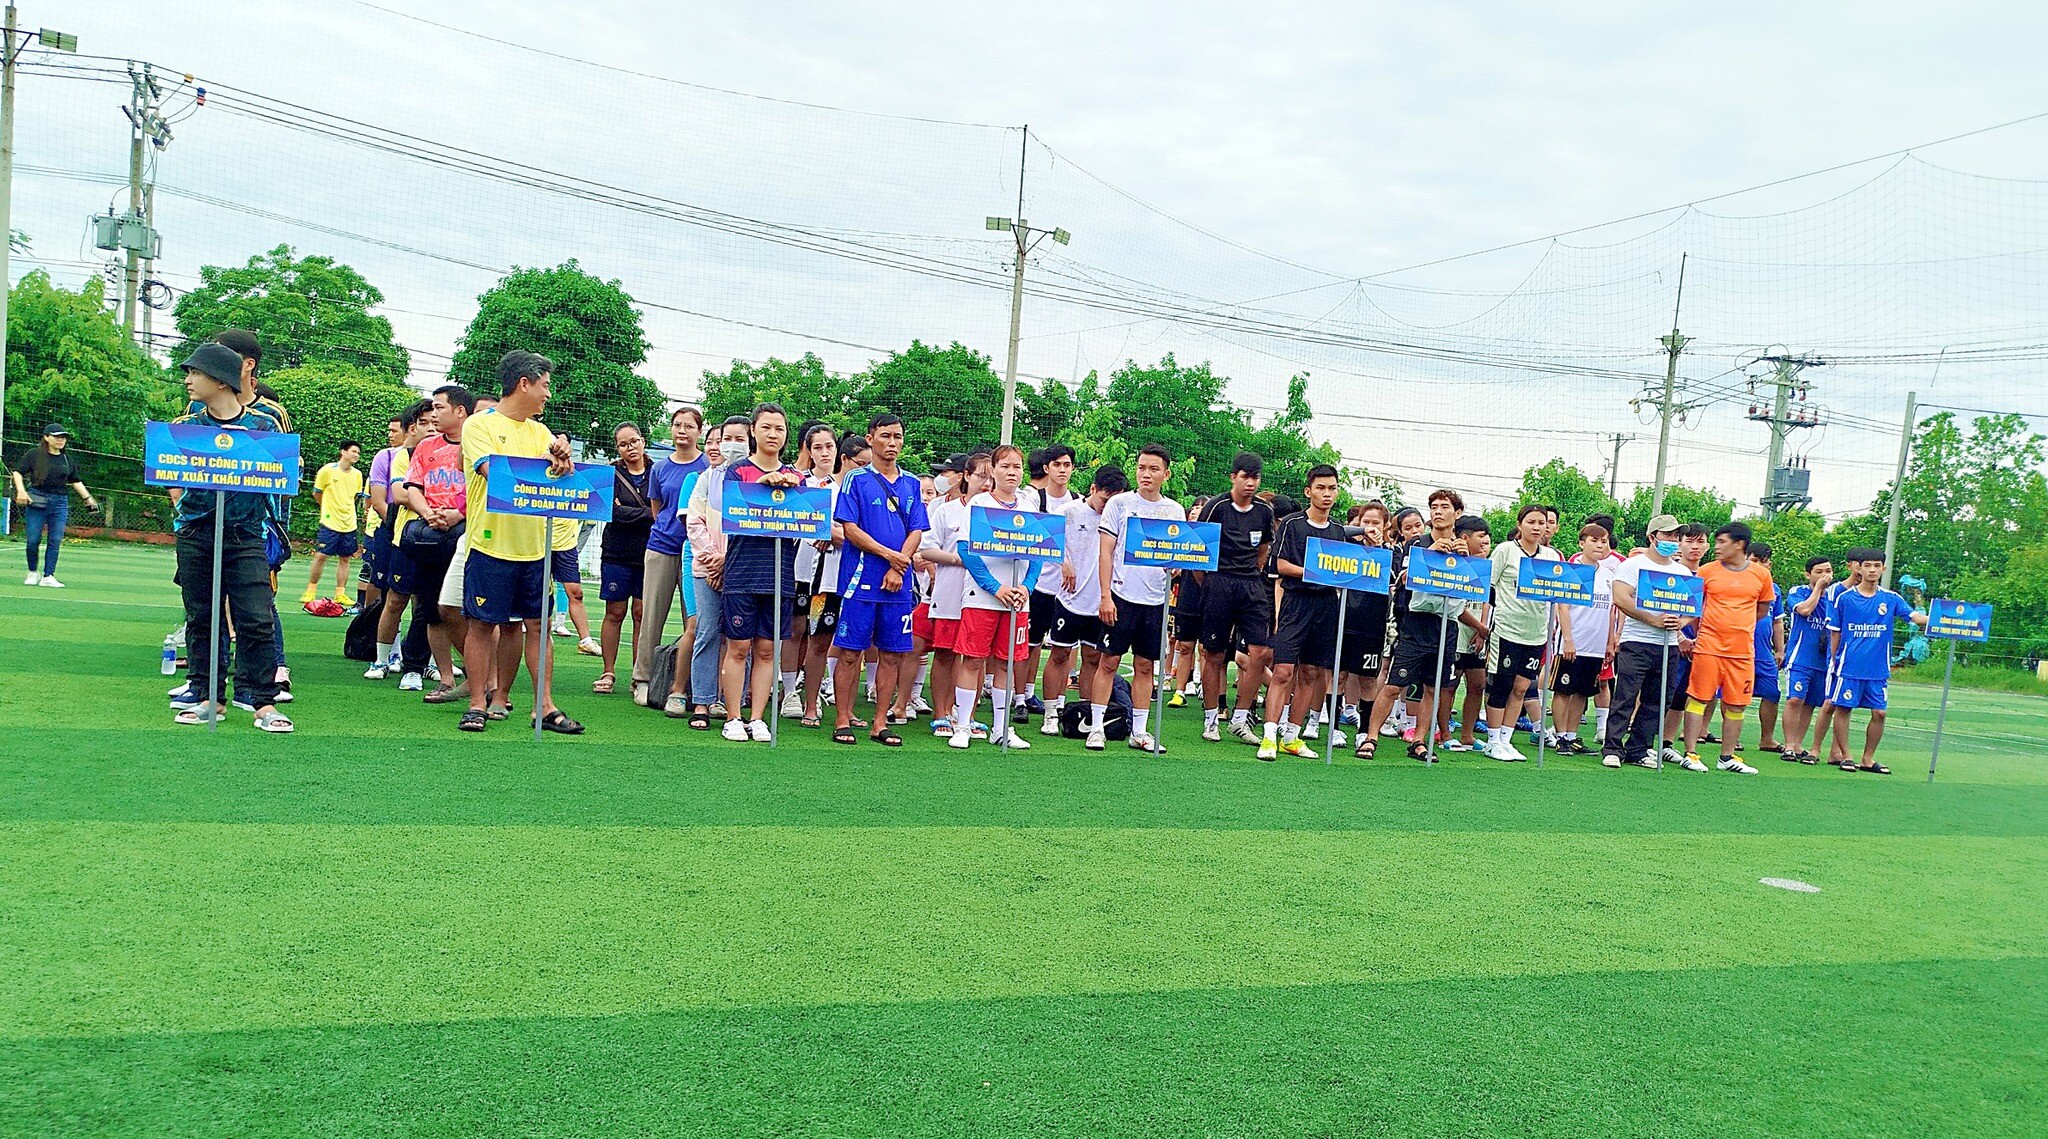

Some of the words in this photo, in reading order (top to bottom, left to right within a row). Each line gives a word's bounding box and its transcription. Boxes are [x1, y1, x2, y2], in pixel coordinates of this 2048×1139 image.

[158, 454, 188, 464] CĐCS
[191, 456, 206, 467] CN
[209, 456, 238, 468] CÔNG
[241, 460, 253, 471] TY
[256, 462, 283, 473] TNHH
[156, 470, 179, 480] MAY
[182, 467, 210, 483] XUẤT
[212, 472, 241, 485] KHẨU
[244, 475, 272, 487] HÙNG
[275, 478, 288, 488] VỸ
[514, 484, 537, 495] CÔNG
[539, 486, 562, 496] ĐOÀN
[565, 489, 576, 498] CƠ
[578, 490, 589, 499] SỞ
[513, 498, 529, 508] TẬP
[531, 499, 555, 509] ĐOÀN
[557, 501, 569, 510] MỸ
[572, 502, 587, 512] LAN
[749, 508, 761, 516] CTY
[763, 508, 773, 517] CỔ
[812, 510, 825, 521] SẢN
[739, 519, 761, 529] THÔNG
[763, 521, 785, 531] THUẬN
[787, 522, 799, 531] TRÀ
[801, 524, 816, 532] VINH
[993, 530, 1009, 539] CÔNG
[1154, 552, 1173, 560] SMART
[1173, 553, 1209, 562] AGRICULTURE
[1318, 553, 1358, 575] TRỌNG
[1362, 559, 1380, 578] TÀI
[1057, 618, 1065, 630] 9
[1848, 623, 1887, 631] Emirates
[1363, 654, 1378, 669] 20
[1526, 657, 1539, 670] 20
